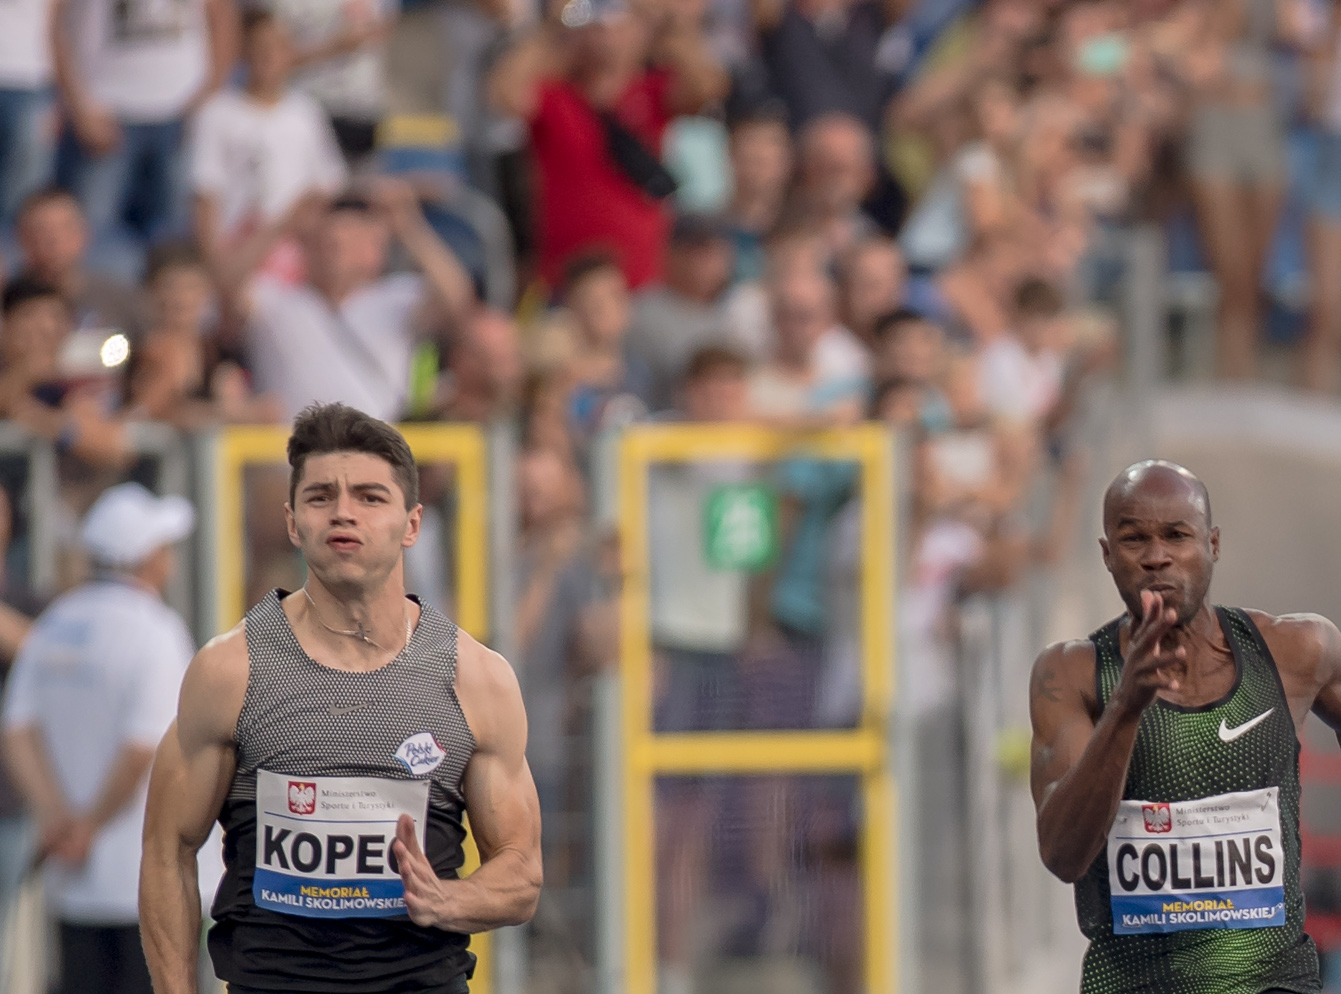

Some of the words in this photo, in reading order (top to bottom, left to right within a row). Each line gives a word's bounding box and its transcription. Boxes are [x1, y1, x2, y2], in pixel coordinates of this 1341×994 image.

[1116, 834, 1276, 892] COLLINS
[261, 889, 303, 907] KAMILI
[305, 896, 407, 910] SKOLIMOWSKIE
[300, 885, 370, 898] MEMORIAŁ
[1122, 913, 1166, 926] KAMILI
[1169, 906, 1276, 924] SKOLIMOWSKIEJ
[1162, 899, 1235, 913] MEMORIAŁ
